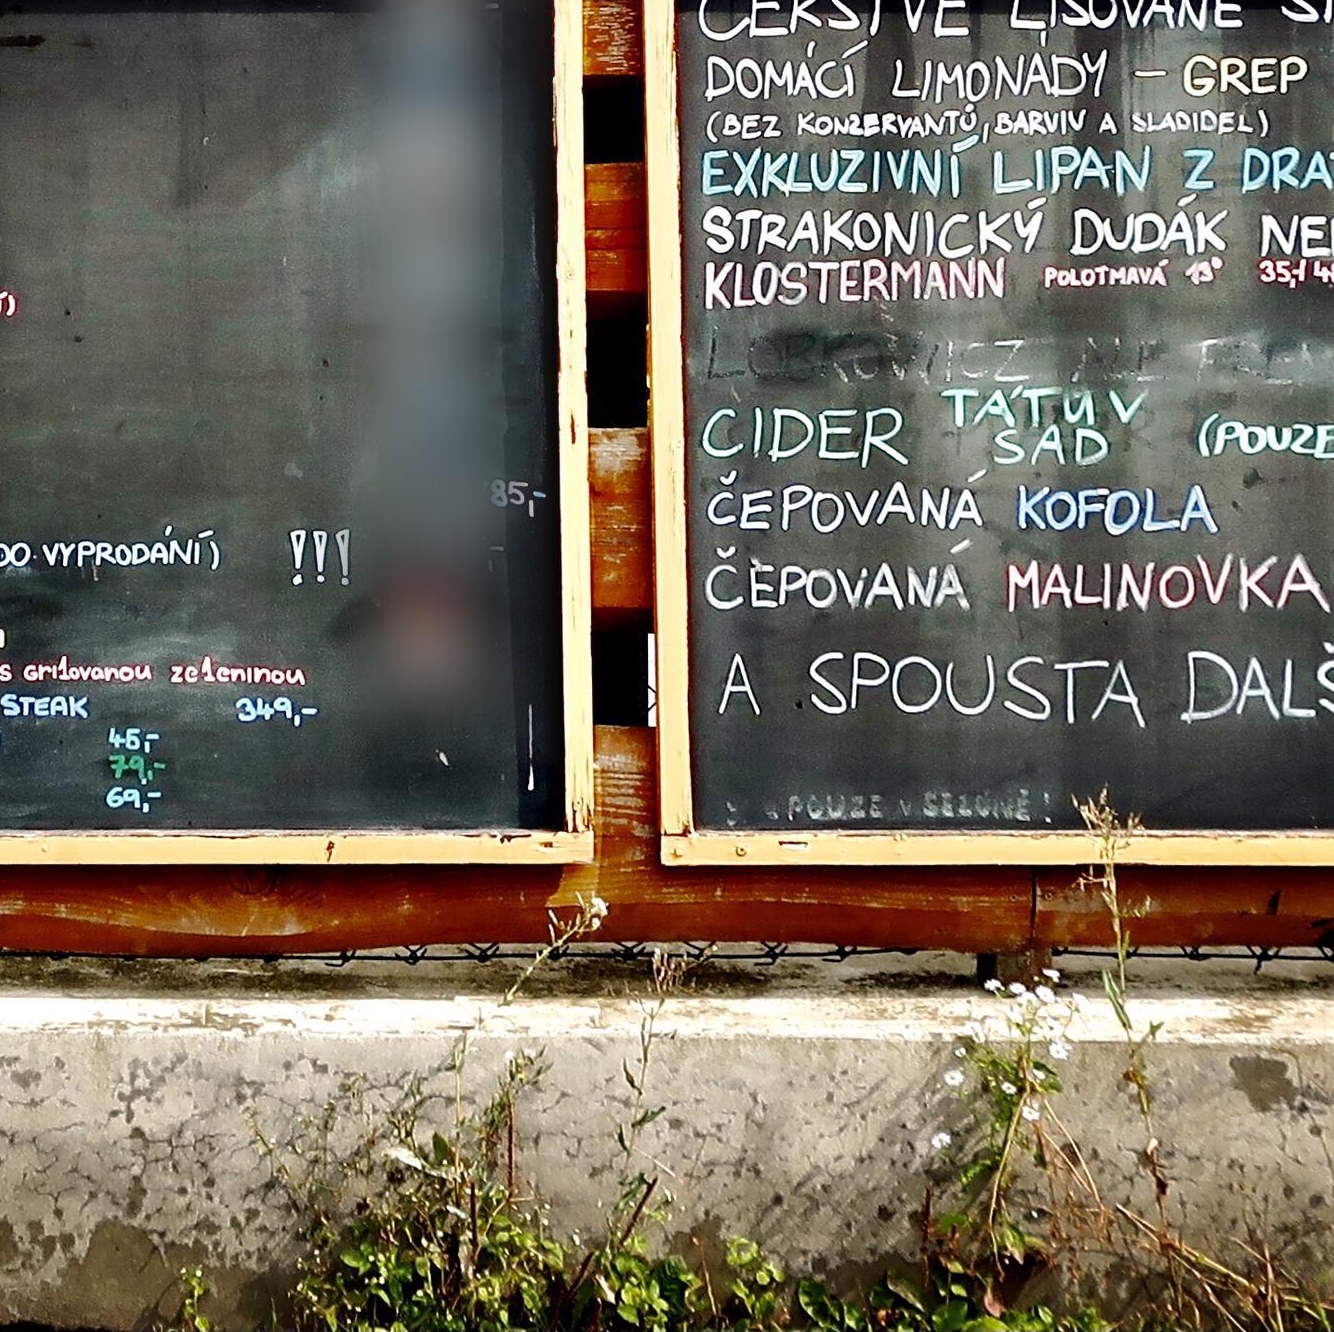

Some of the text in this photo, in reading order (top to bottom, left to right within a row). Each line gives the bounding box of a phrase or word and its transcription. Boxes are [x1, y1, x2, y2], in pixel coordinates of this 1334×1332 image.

[892, 30, 1108, 104] LIMONÁDY
[1183, 54, 1308, 98] GREP
[995, 111, 1086, 136] BARVIV
[1130, 107, 1269, 138] SLADIDEL)
[701, 134, 983, 198] EXKLUZIVNÍ
[993, 145, 1152, 197] LIPAN
[701, 195, 1049, 258] STRAKONICKÝ
[1069, 192, 1230, 258] DUDÁK
[704, 256, 1169, 311] KLOSTERMANN POLOTMAVÁ
[701, 406, 909, 467] CIDER
[993, 428, 1110, 466] SAD
[706, 468, 1220, 536] ČEPOVANÁ KOFOLA
[42, 524, 220, 571] VYPRODÁNÍ)
[1005, 553, 1331, 613] MALINOVKA
[0, 693, 90, 718] STEAK
[809, 651, 1147, 728] SPOUSTA
